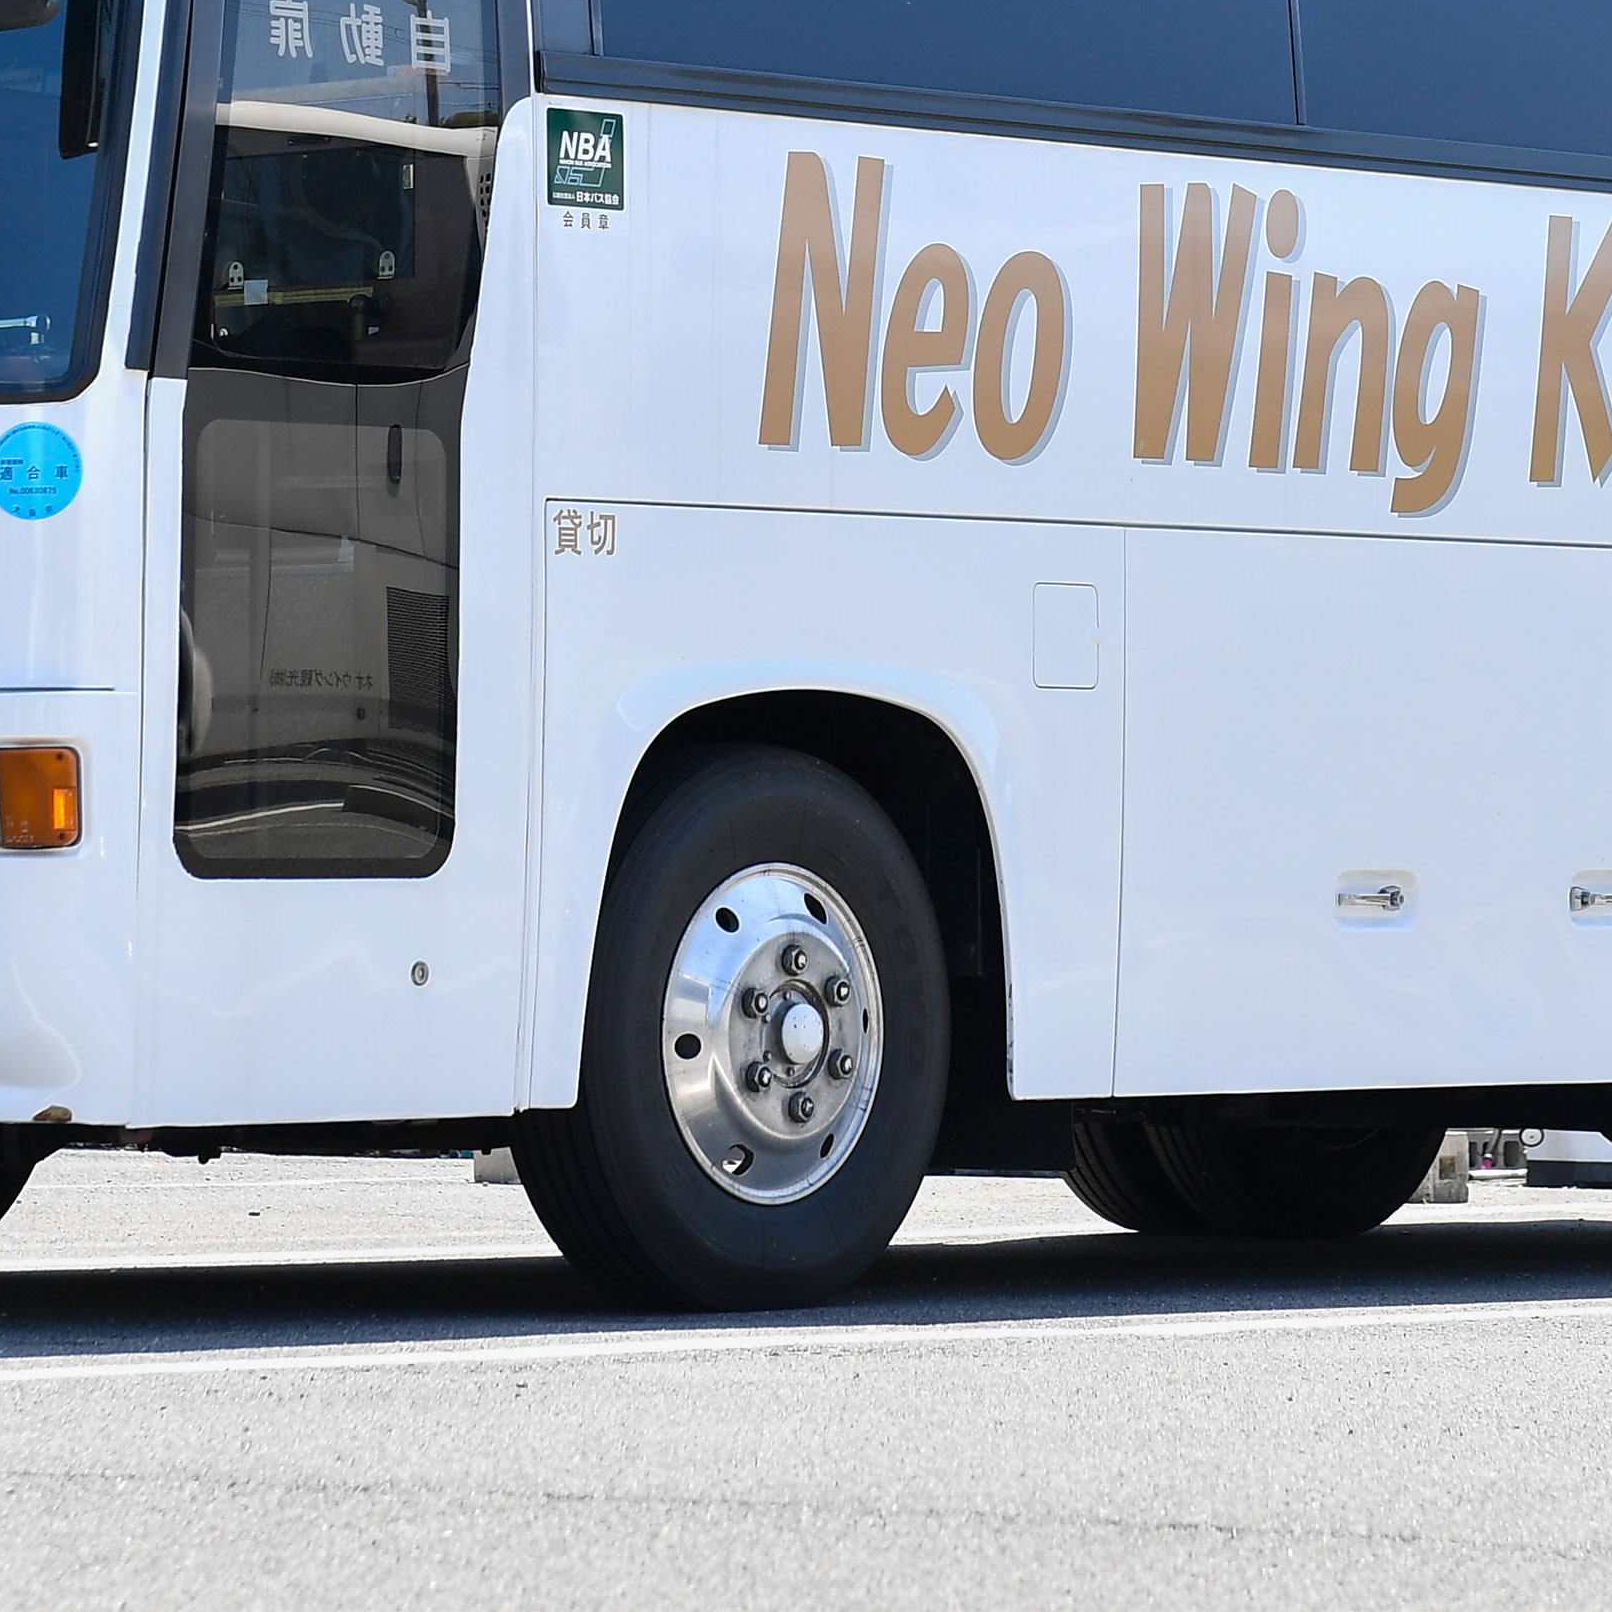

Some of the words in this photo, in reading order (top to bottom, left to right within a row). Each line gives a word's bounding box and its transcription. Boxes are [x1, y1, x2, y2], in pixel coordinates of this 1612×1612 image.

[559, 130, 612, 163] NBA
[576, 190, 620, 206] 日本バス協会
[562, 210, 610, 230] 会員章
[758, 150, 1073, 464] Neo
[1132, 181, 1486, 518] Wing
[551, 508, 617, 556] 貸切
